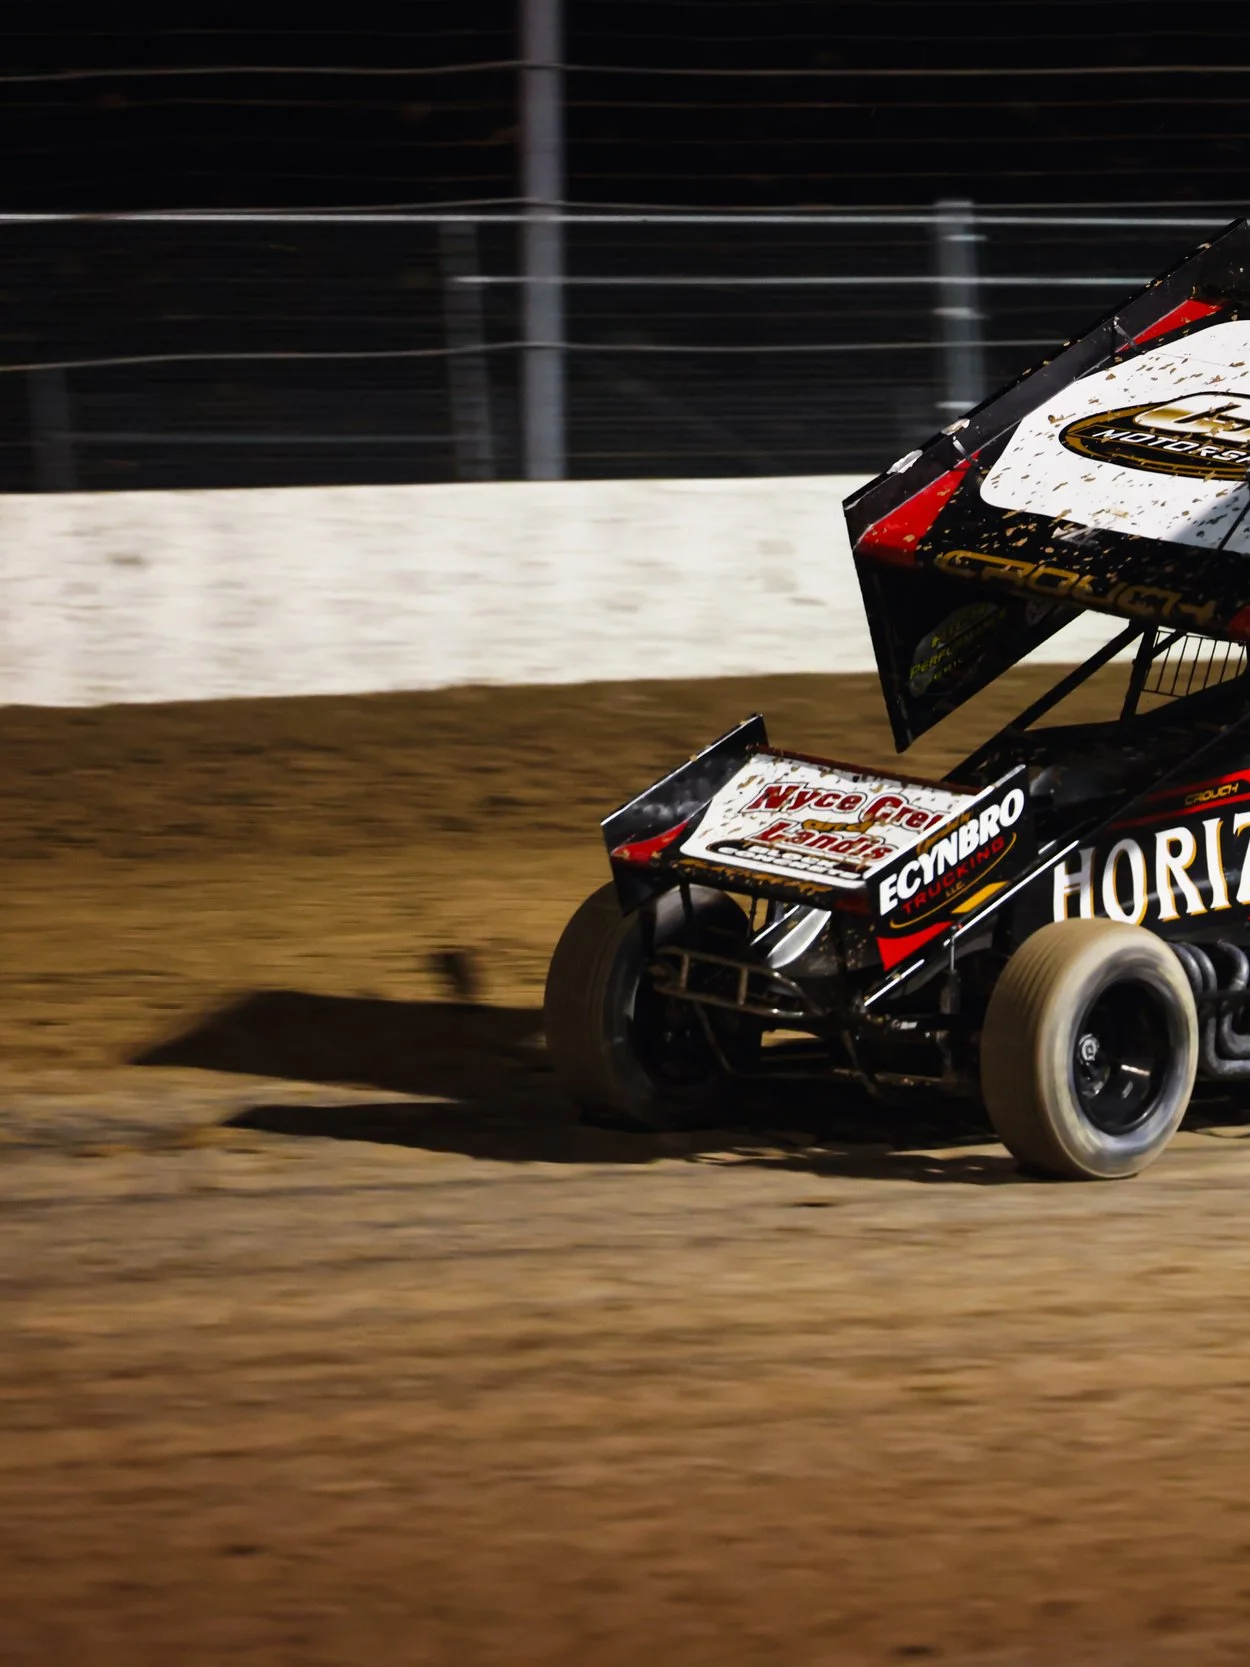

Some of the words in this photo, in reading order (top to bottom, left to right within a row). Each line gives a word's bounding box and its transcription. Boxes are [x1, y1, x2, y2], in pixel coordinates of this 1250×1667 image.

[747, 785, 863, 813] Nyce
[1184, 782, 1240, 806] CROUCH
[752, 820, 893, 860] Landis
[879, 788, 1025, 916] ECYNBRO
[902, 836, 1005, 915] TRUCKING
